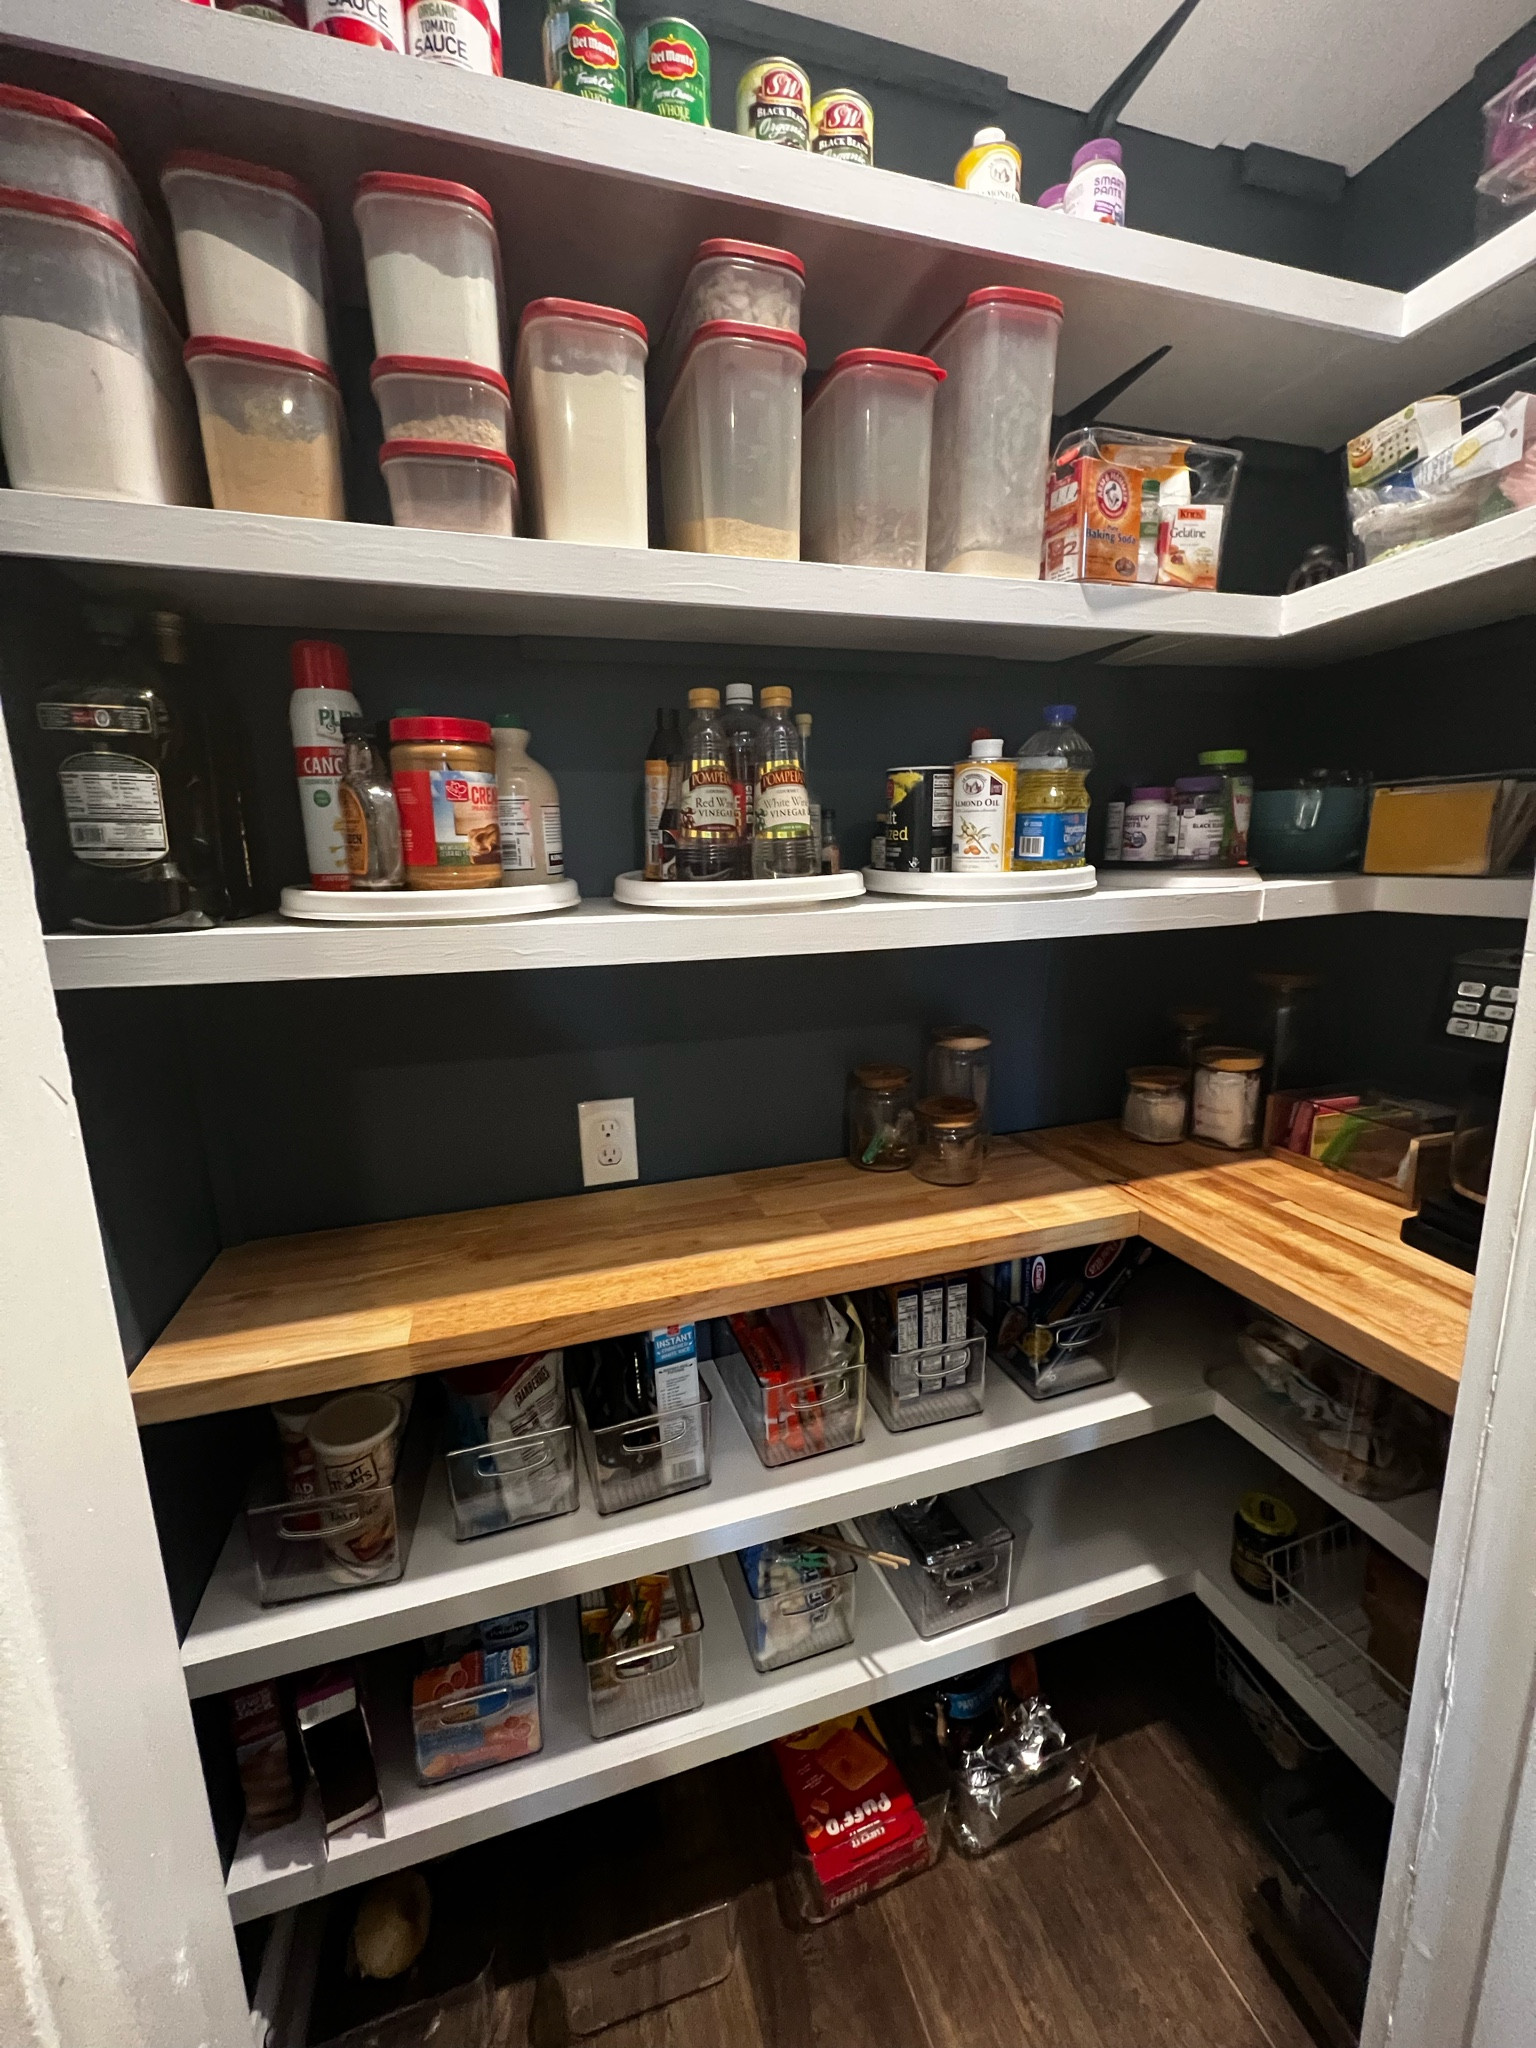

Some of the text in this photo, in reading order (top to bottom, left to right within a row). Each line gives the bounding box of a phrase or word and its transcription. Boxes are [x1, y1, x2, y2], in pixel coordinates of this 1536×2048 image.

[417, 3, 458, 21] ORGANIC
[420, 19, 456, 35] TOMATO
[414, 36, 469, 61] SAUCE
[757, 106, 785, 118] BLACK
[819, 138, 846, 150] BLACK
[1086, 527, 1136, 544] Baking Soda
[1169, 527, 1207, 539] Gelatine
[695, 797, 715, 808] Red
[763, 799, 790, 809] White
[770, 808, 807, 818] VINEGAR
[656, 1331, 693, 1349] INSTANT
[514, 1365, 551, 1408] CRANBERRIES
